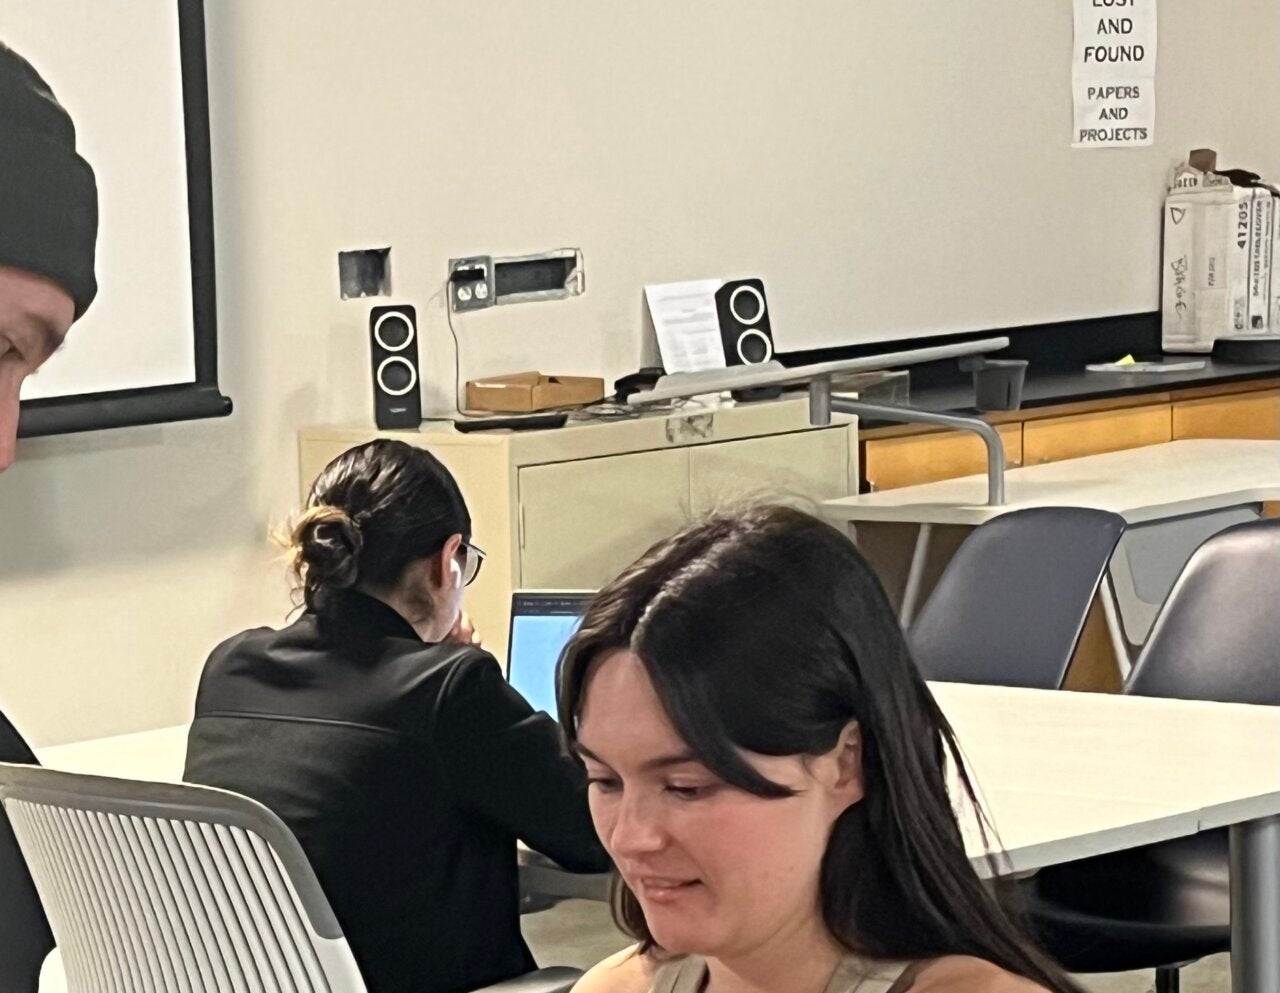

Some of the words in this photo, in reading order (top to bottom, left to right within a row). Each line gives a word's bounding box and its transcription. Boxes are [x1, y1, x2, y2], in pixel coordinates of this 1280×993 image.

[1097, 18, 1133, 35] AND
[1084, 45, 1145, 63] FOUND
[1087, 86, 1140, 100] PAPERS
[1099, 107, 1129, 121] AND
[1079, 127, 1148, 143] PROJECTS
